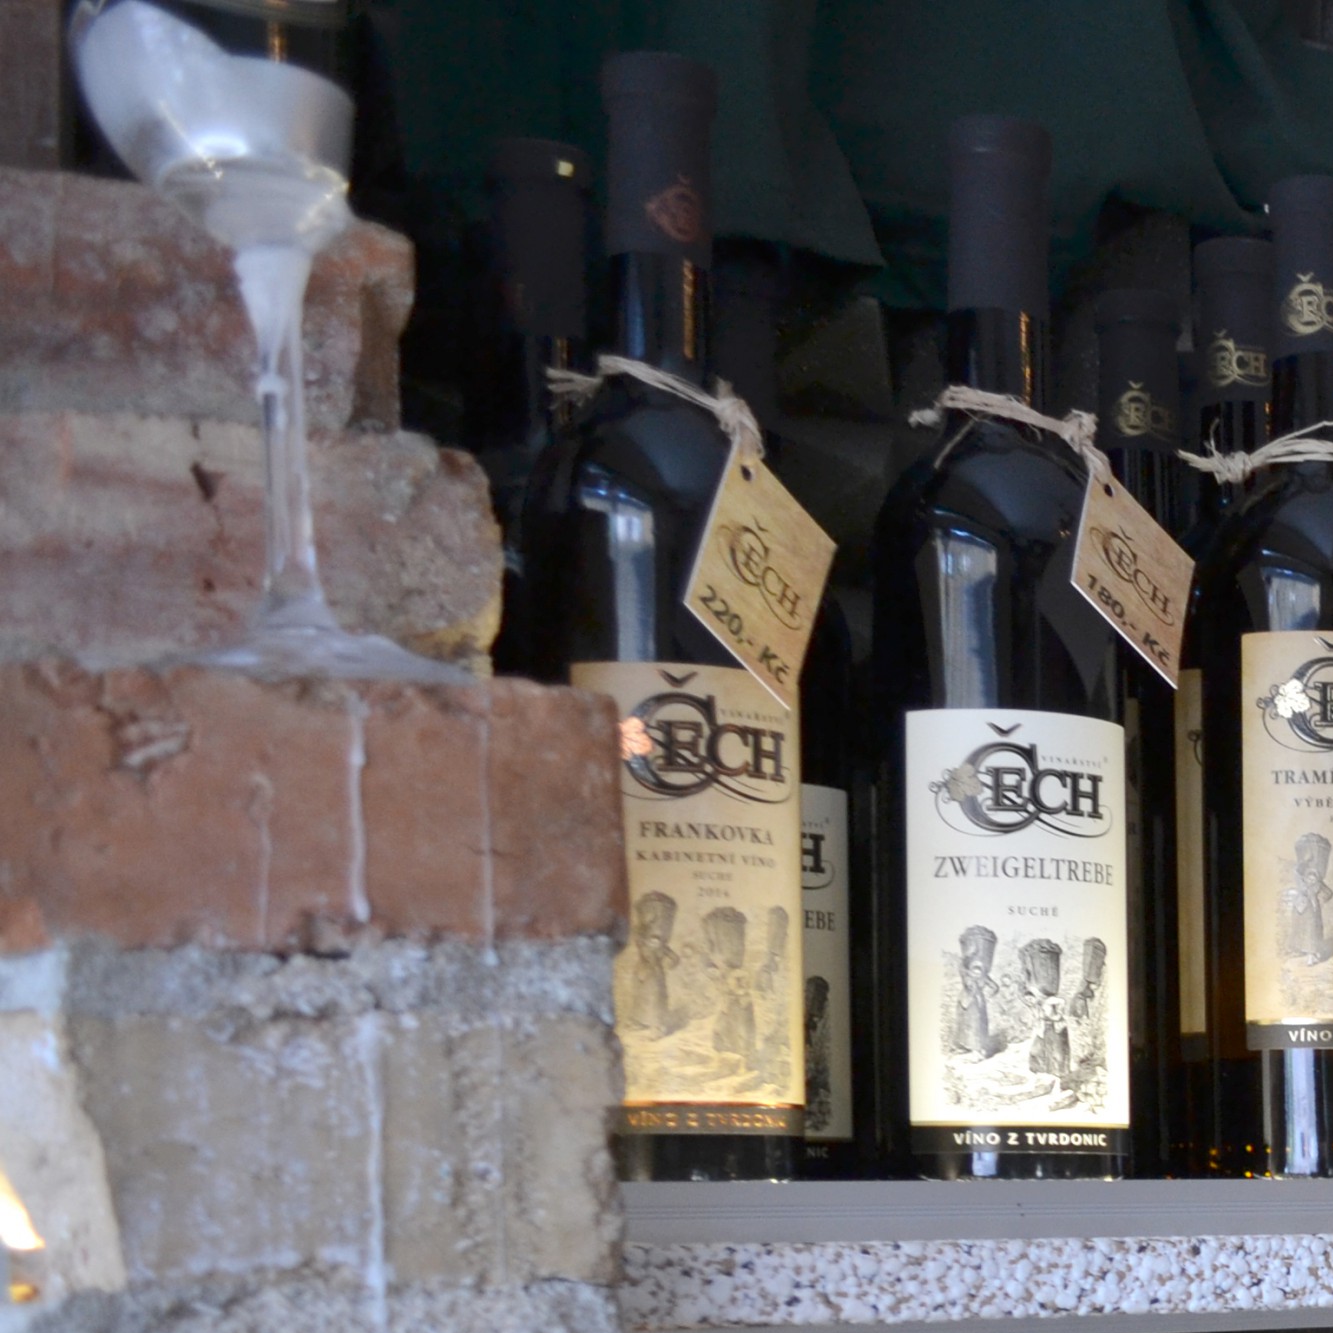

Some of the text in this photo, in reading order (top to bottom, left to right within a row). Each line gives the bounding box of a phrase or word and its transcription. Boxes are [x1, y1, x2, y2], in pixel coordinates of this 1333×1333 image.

[1087, 573, 1172, 668] 180,- Kč
[698, 585, 791, 686] 220,- Kč
[639, 821, 775, 847] FRANKOVKA
[933, 854, 1115, 887] ZWEIGELTREBE
[1007, 903, 1060, 919] SUCHÉ
[1288, 1026, 1332, 1044] VÍNO
[953, 1128, 1107, 1148] VÍNO Z TVRDONIC
